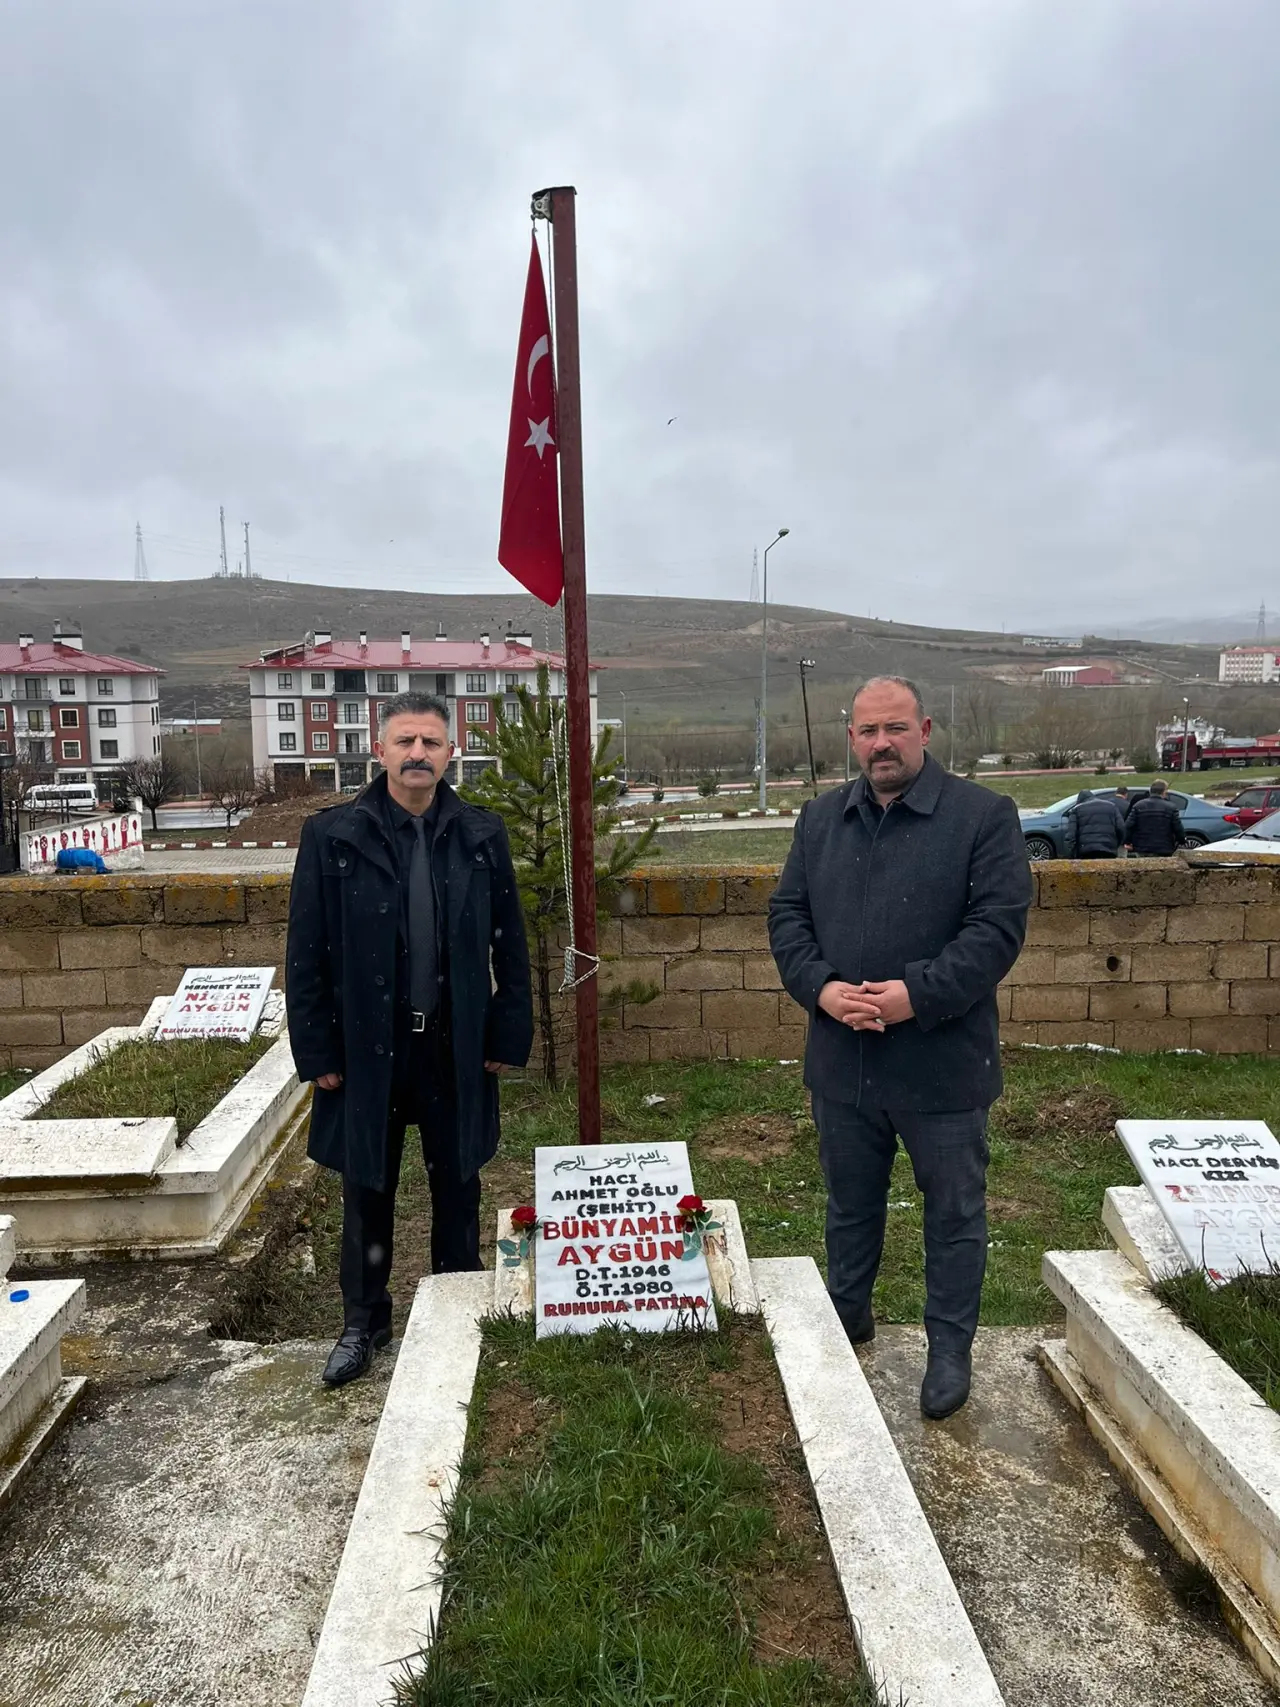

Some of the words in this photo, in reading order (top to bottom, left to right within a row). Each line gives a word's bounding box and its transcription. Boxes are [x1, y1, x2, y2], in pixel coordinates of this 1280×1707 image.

[179, 1001, 250, 1012] AYGÜN
[1152, 1157, 1203, 1168] HACI
[590, 1174, 638, 1186] HACI
[551, 1188, 619, 1201] AHMET
[627, 1183, 678, 1197] OĞLU
[576, 1199, 657, 1218] (ŞEHİT)
[556, 1236, 684, 1266] AYGÜN
[575, 1264, 671, 1281] D.T.1946
[576, 1281, 674, 1298] Ö.T.1980
[544, 1300, 629, 1316] RUHUNA
[635, 1294, 708, 1311] FATİHA
